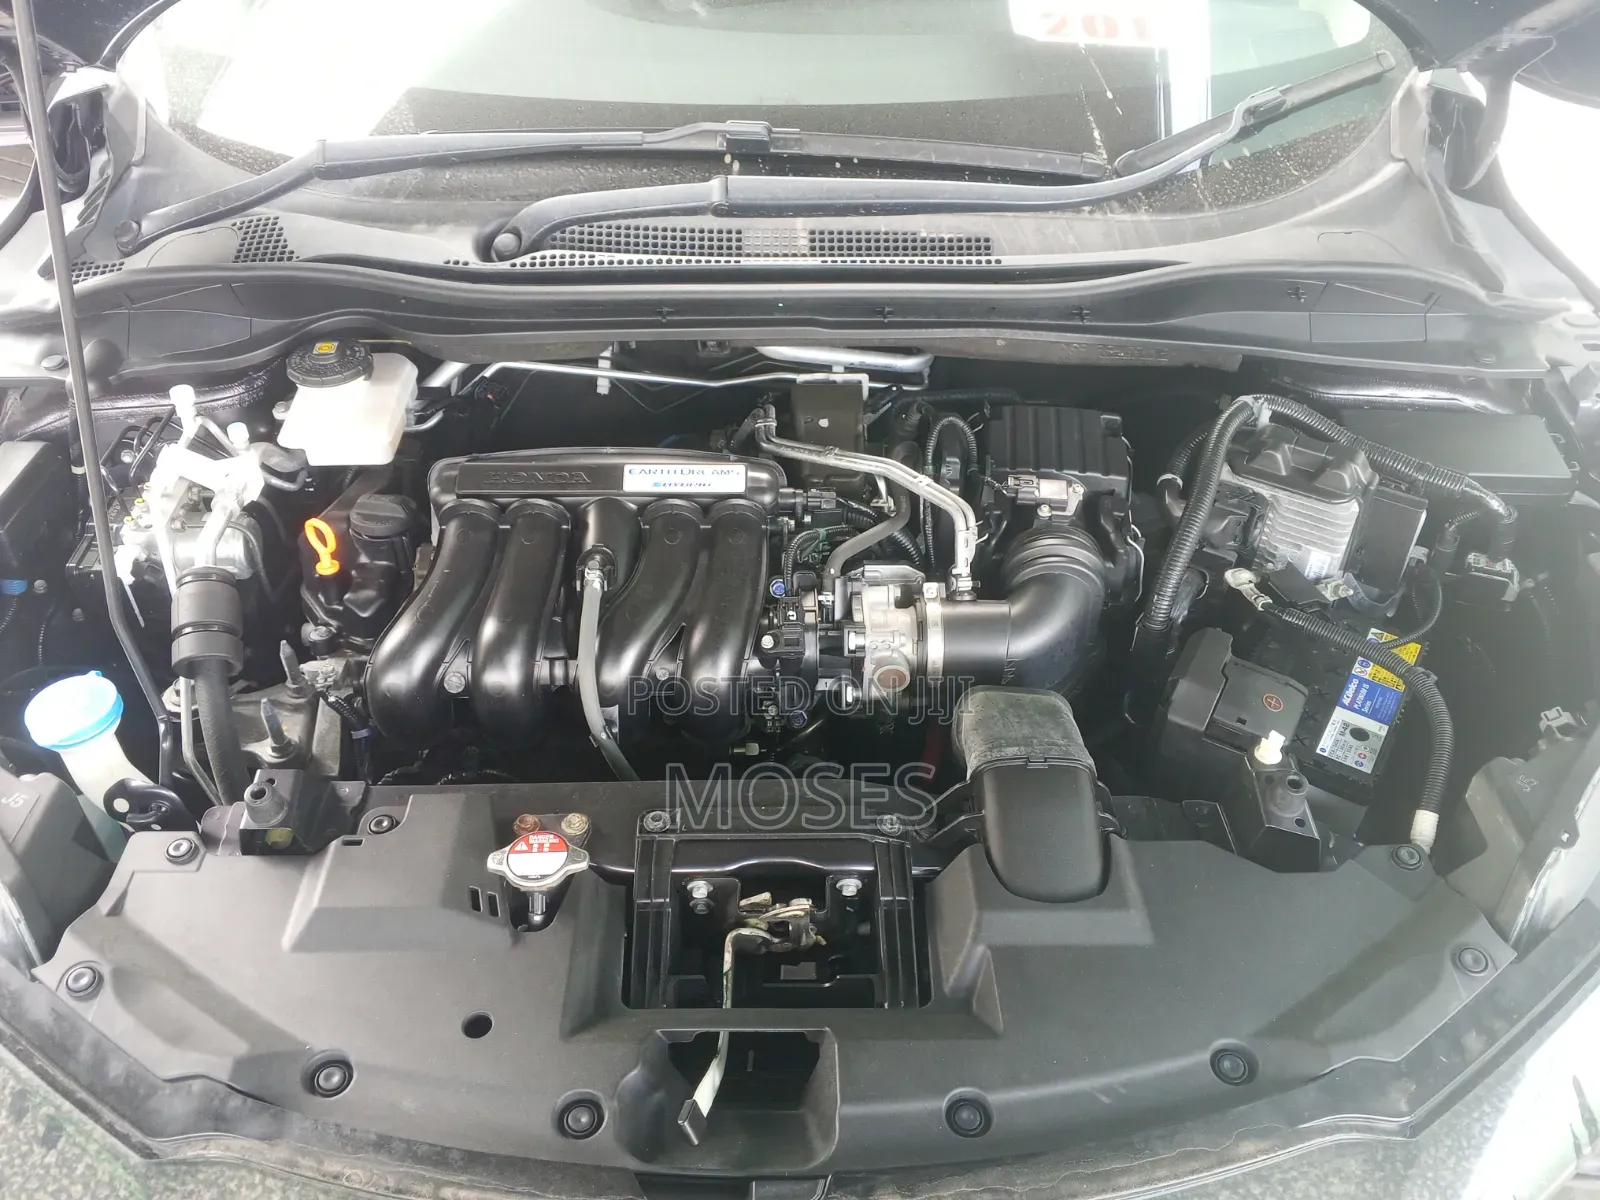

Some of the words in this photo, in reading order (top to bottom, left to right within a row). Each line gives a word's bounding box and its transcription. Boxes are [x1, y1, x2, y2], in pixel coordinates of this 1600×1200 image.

[483, 471, 592, 484] HONDA
[1341, 678, 1360, 707] ACDelco
[1361, 700, 1372, 714] Series
